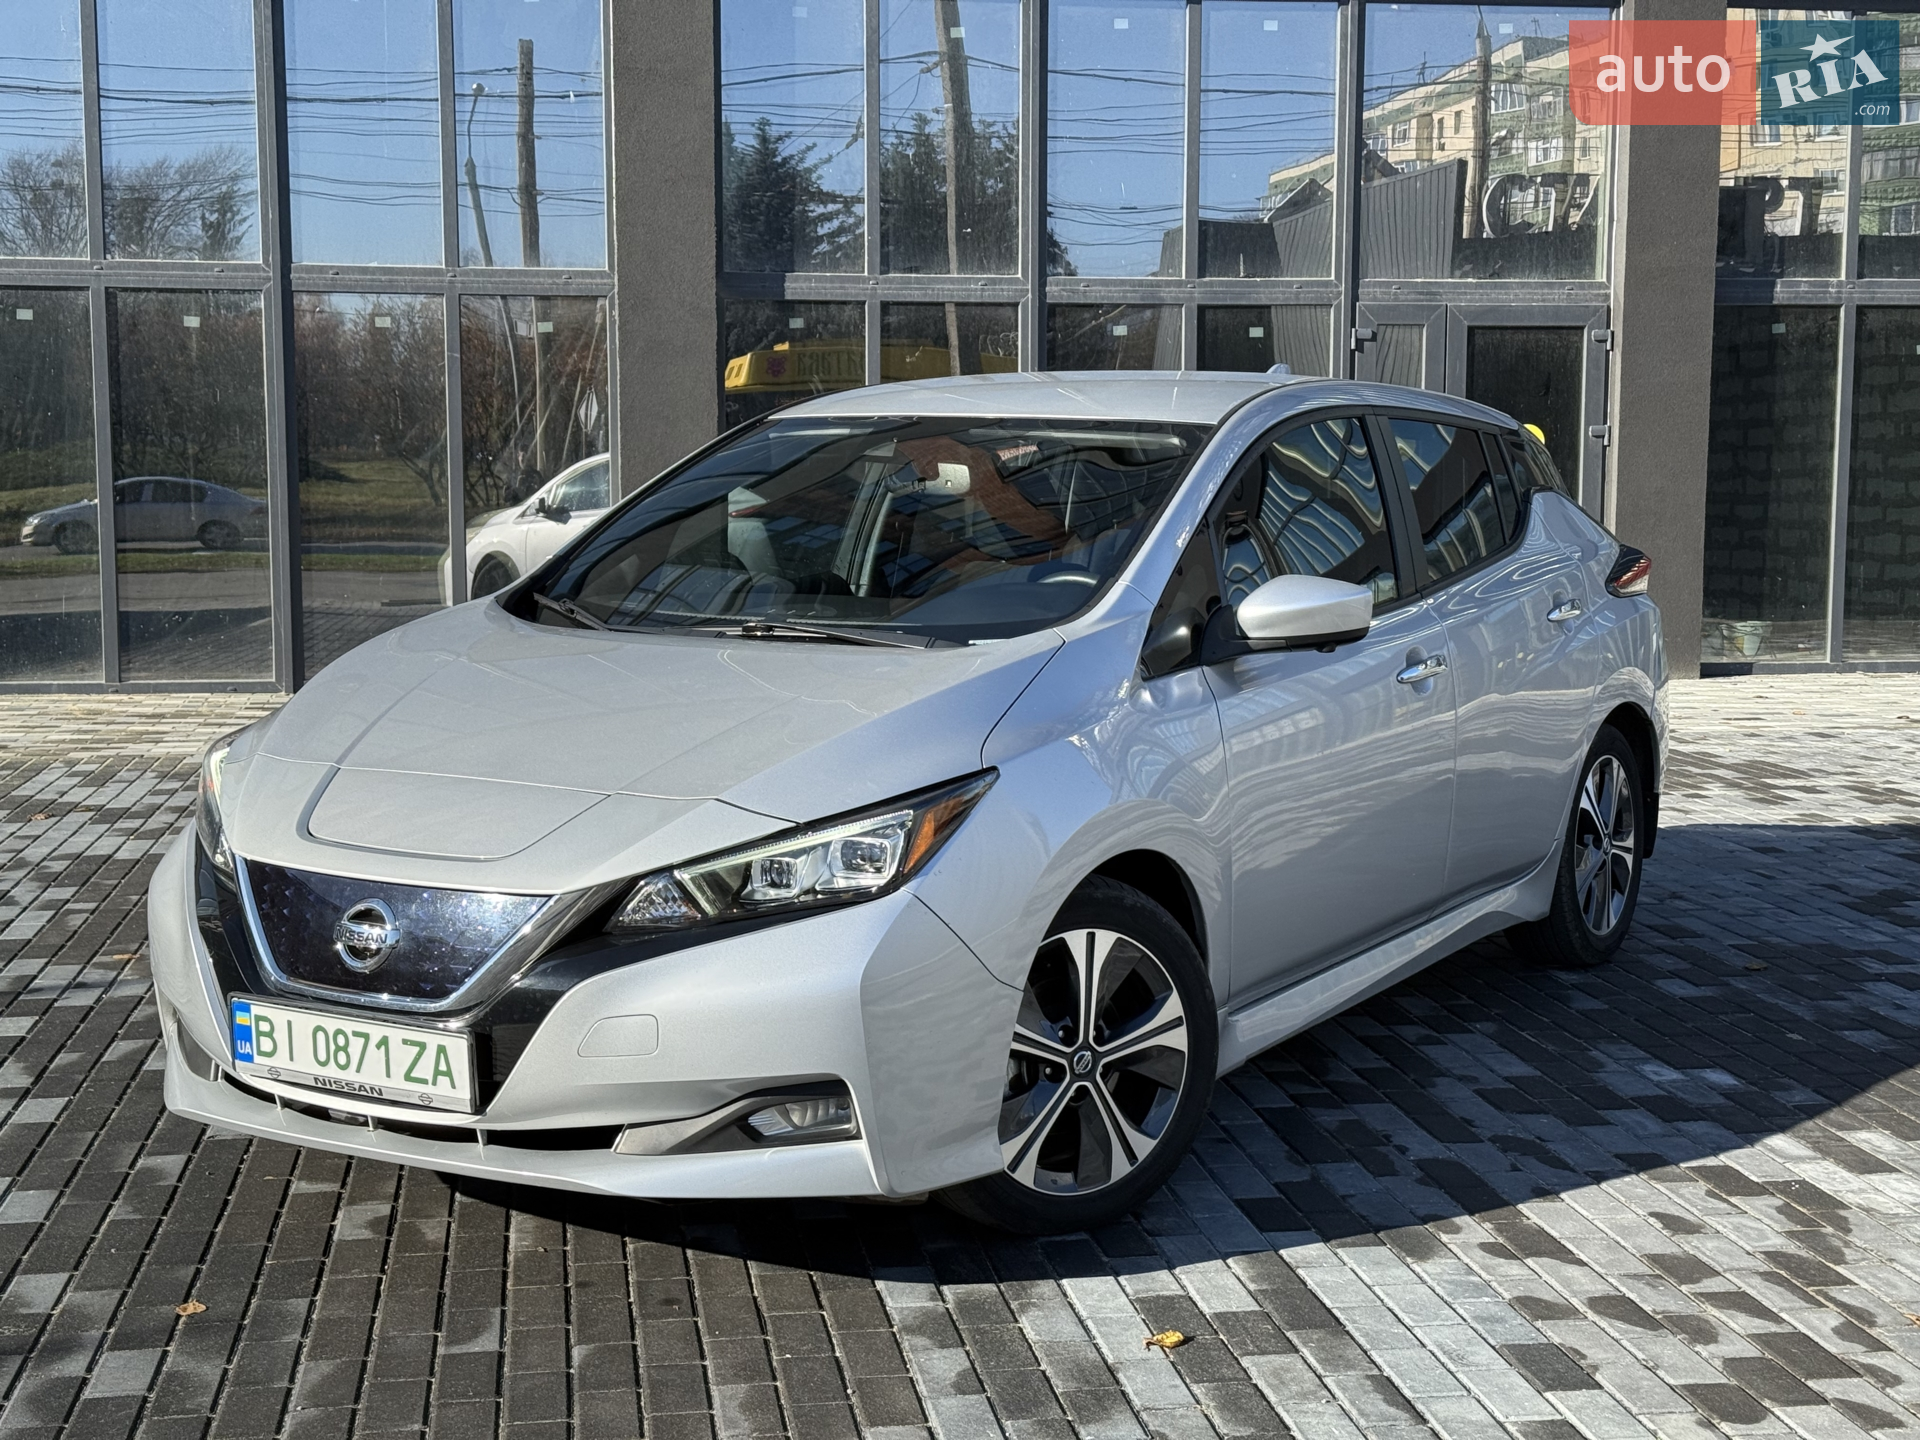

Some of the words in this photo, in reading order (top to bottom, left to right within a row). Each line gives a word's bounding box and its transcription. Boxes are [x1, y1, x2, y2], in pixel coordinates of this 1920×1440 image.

[334, 927, 388, 945] NISSAN
[237, 1040, 253, 1055] UA
[253, 1014, 294, 1062] BI
[311, 1024, 391, 1079] 0871
[402, 1037, 457, 1090] ZA
[313, 1076, 384, 1097] NISSAN
